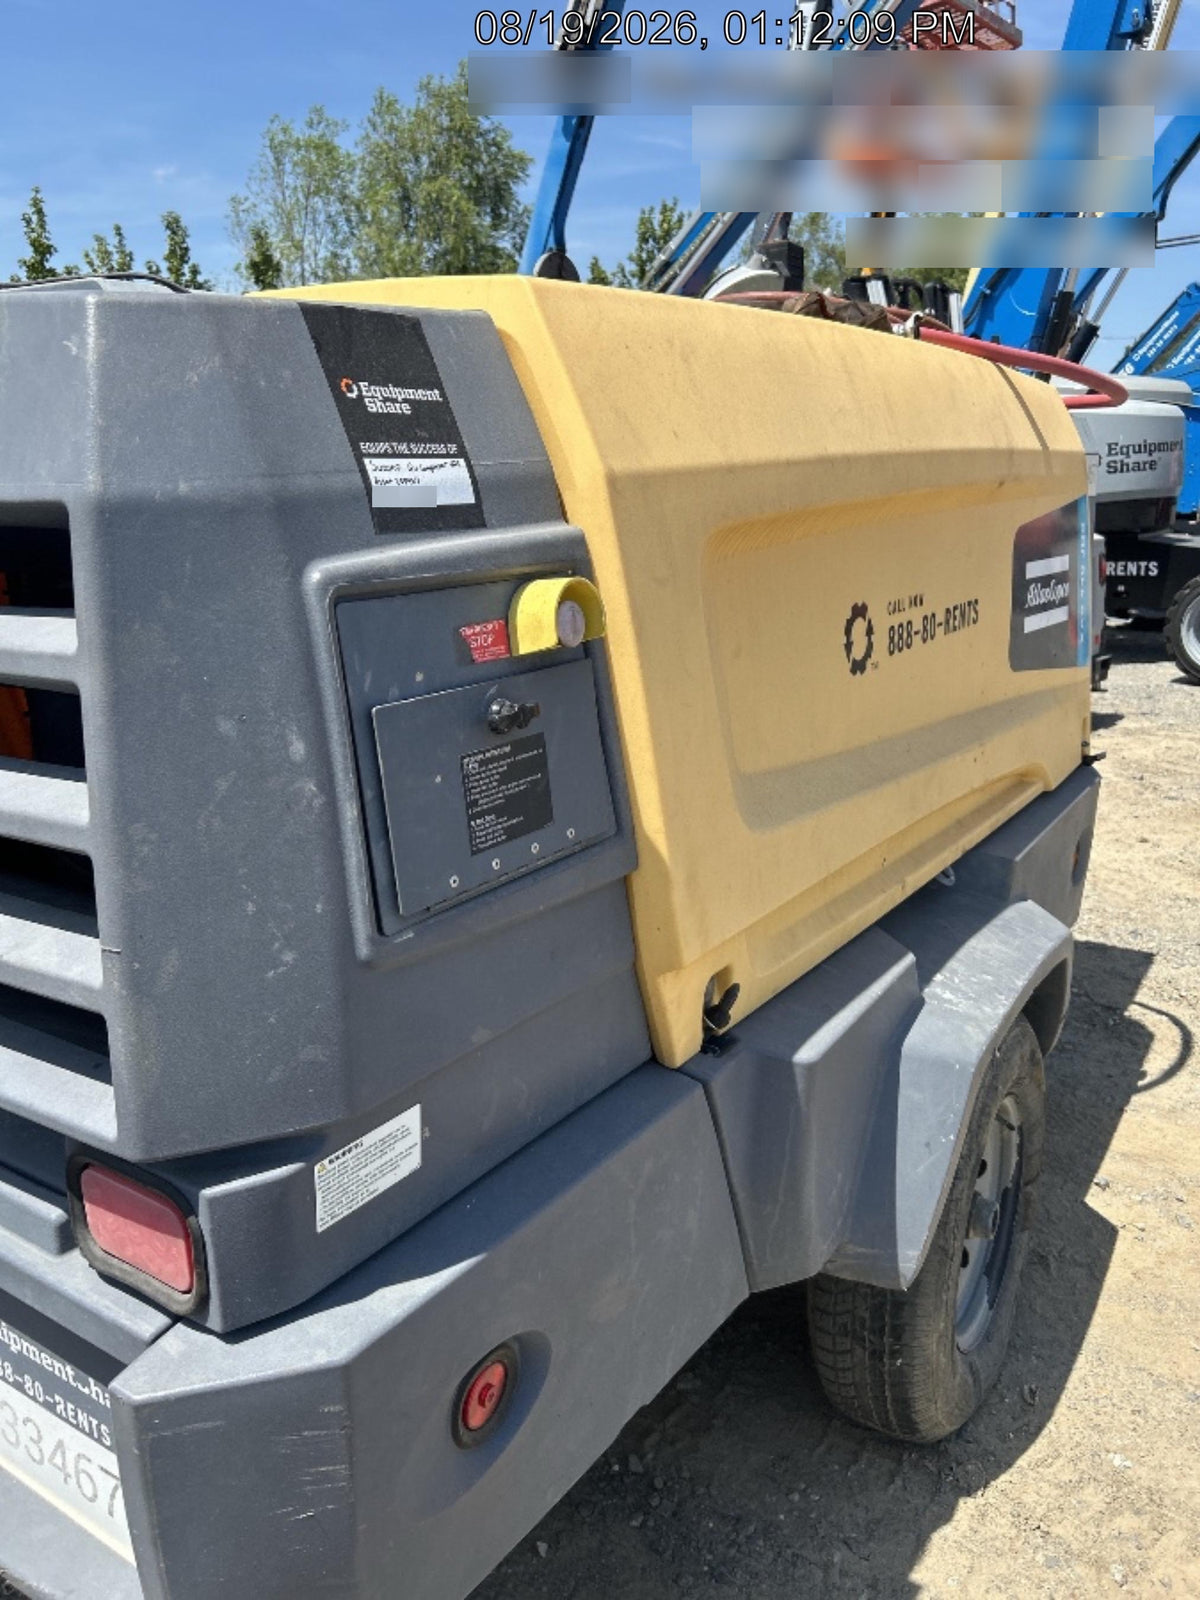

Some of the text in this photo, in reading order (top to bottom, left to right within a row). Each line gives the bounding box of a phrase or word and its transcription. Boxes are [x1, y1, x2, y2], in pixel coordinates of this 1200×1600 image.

[358, 382, 443, 401] Equipment
[364, 398, 412, 415] Share
[1105, 459, 1158, 474] Share
[1105, 560, 1158, 577] RENTS
[888, 598, 979, 657] 888-80-RENTS
